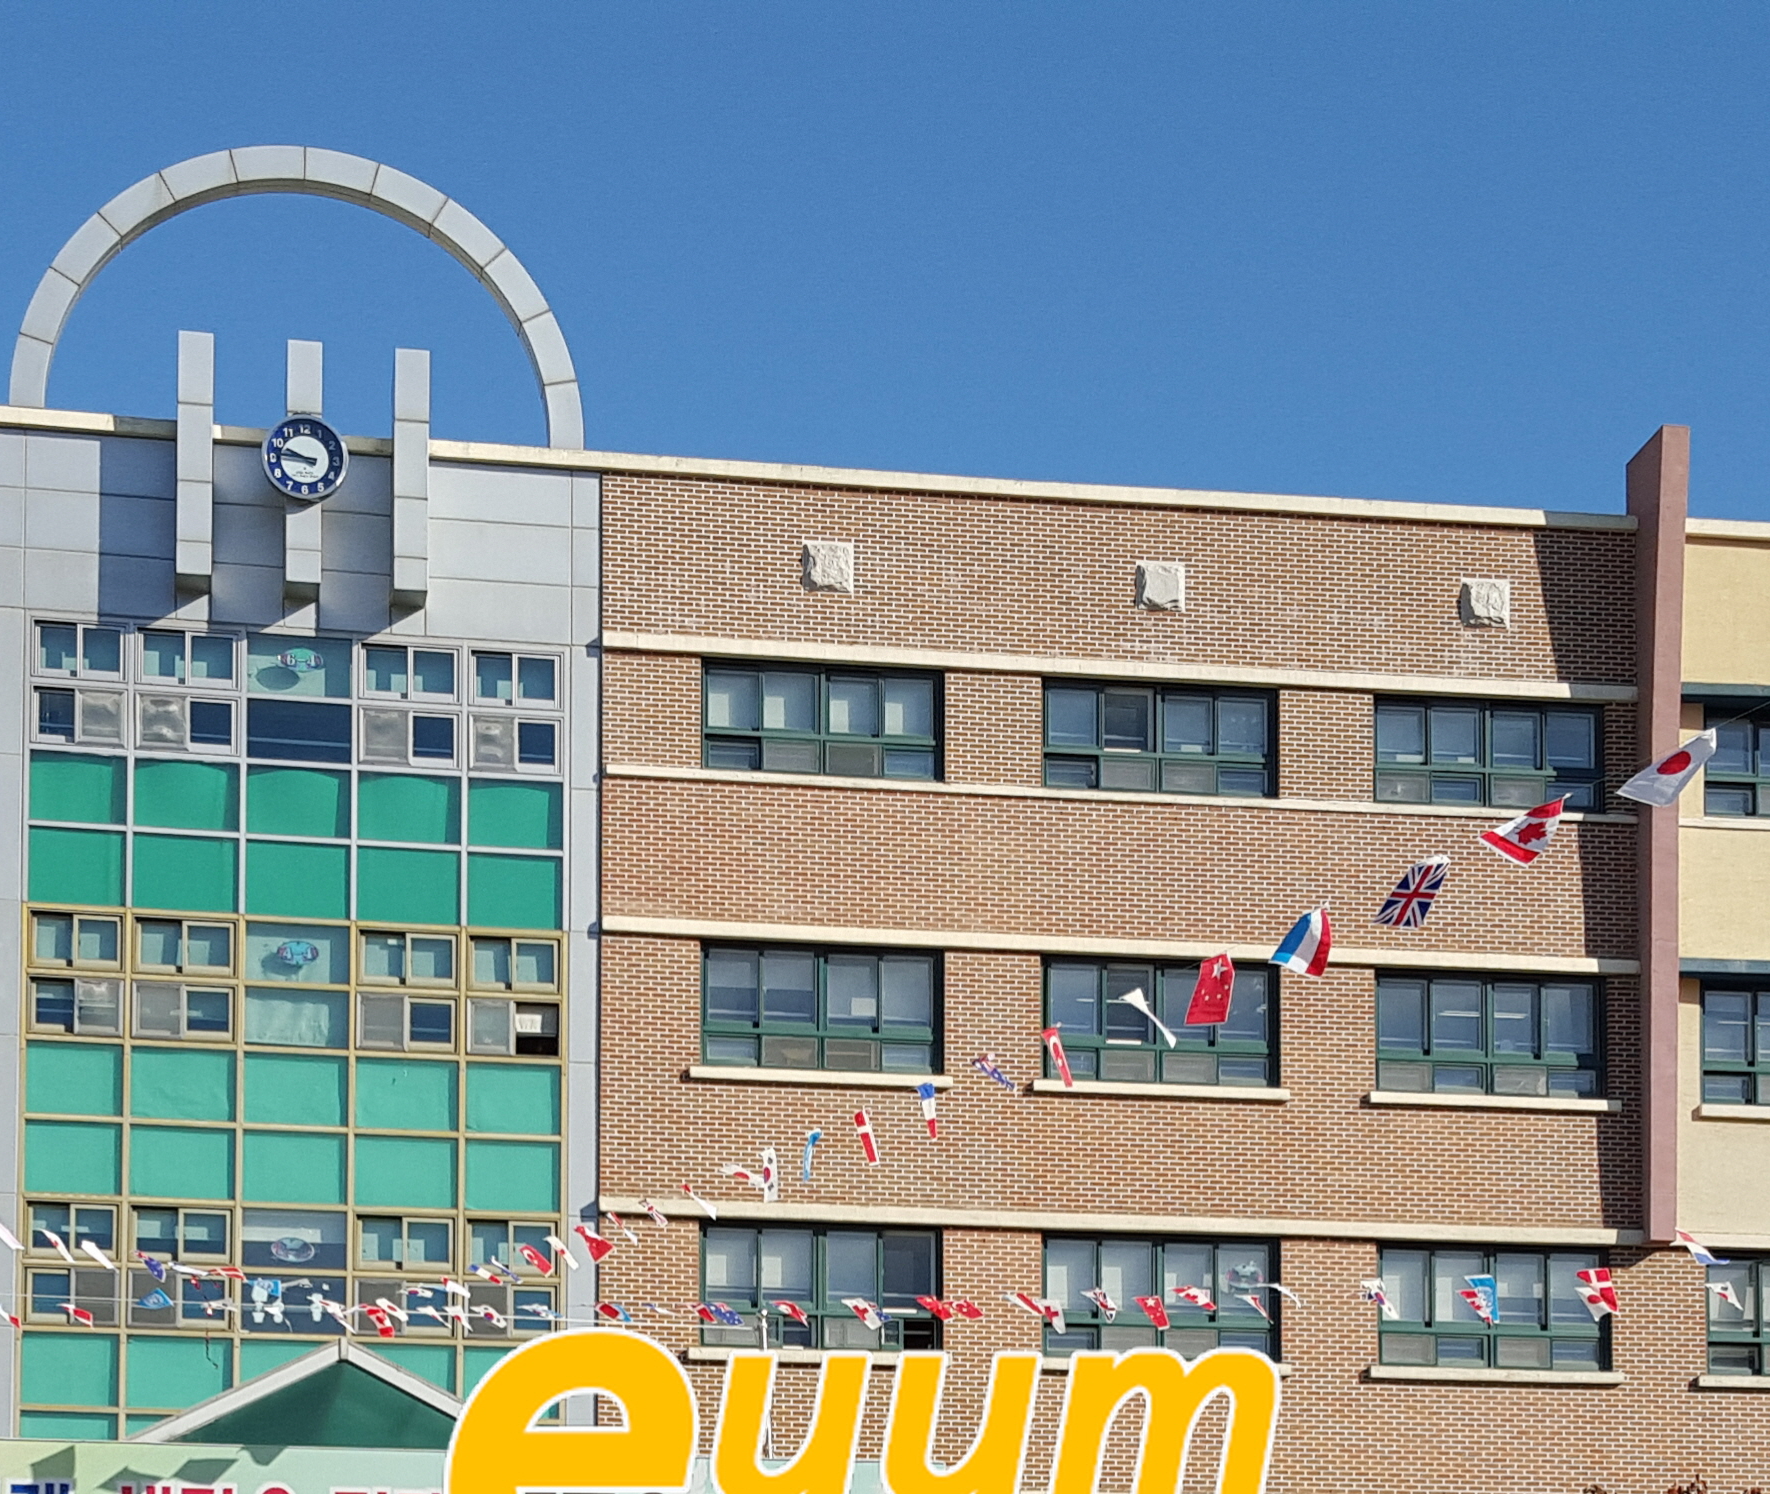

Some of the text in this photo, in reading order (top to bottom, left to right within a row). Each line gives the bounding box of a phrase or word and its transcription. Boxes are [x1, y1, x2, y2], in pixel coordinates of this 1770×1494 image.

[283, 427, 294, 437] 11
[299, 424, 311, 434] 12
[318, 429, 322, 438] 1
[271, 438, 284, 448] 10
[329, 441, 336, 450] 2
[332, 456, 340, 466] 3
[274, 468, 282, 478] 8
[328, 471, 335, 480] 4
[286, 481, 293, 491] 7
[301, 485, 309, 495] 6
[317, 482, 324, 492] 5
